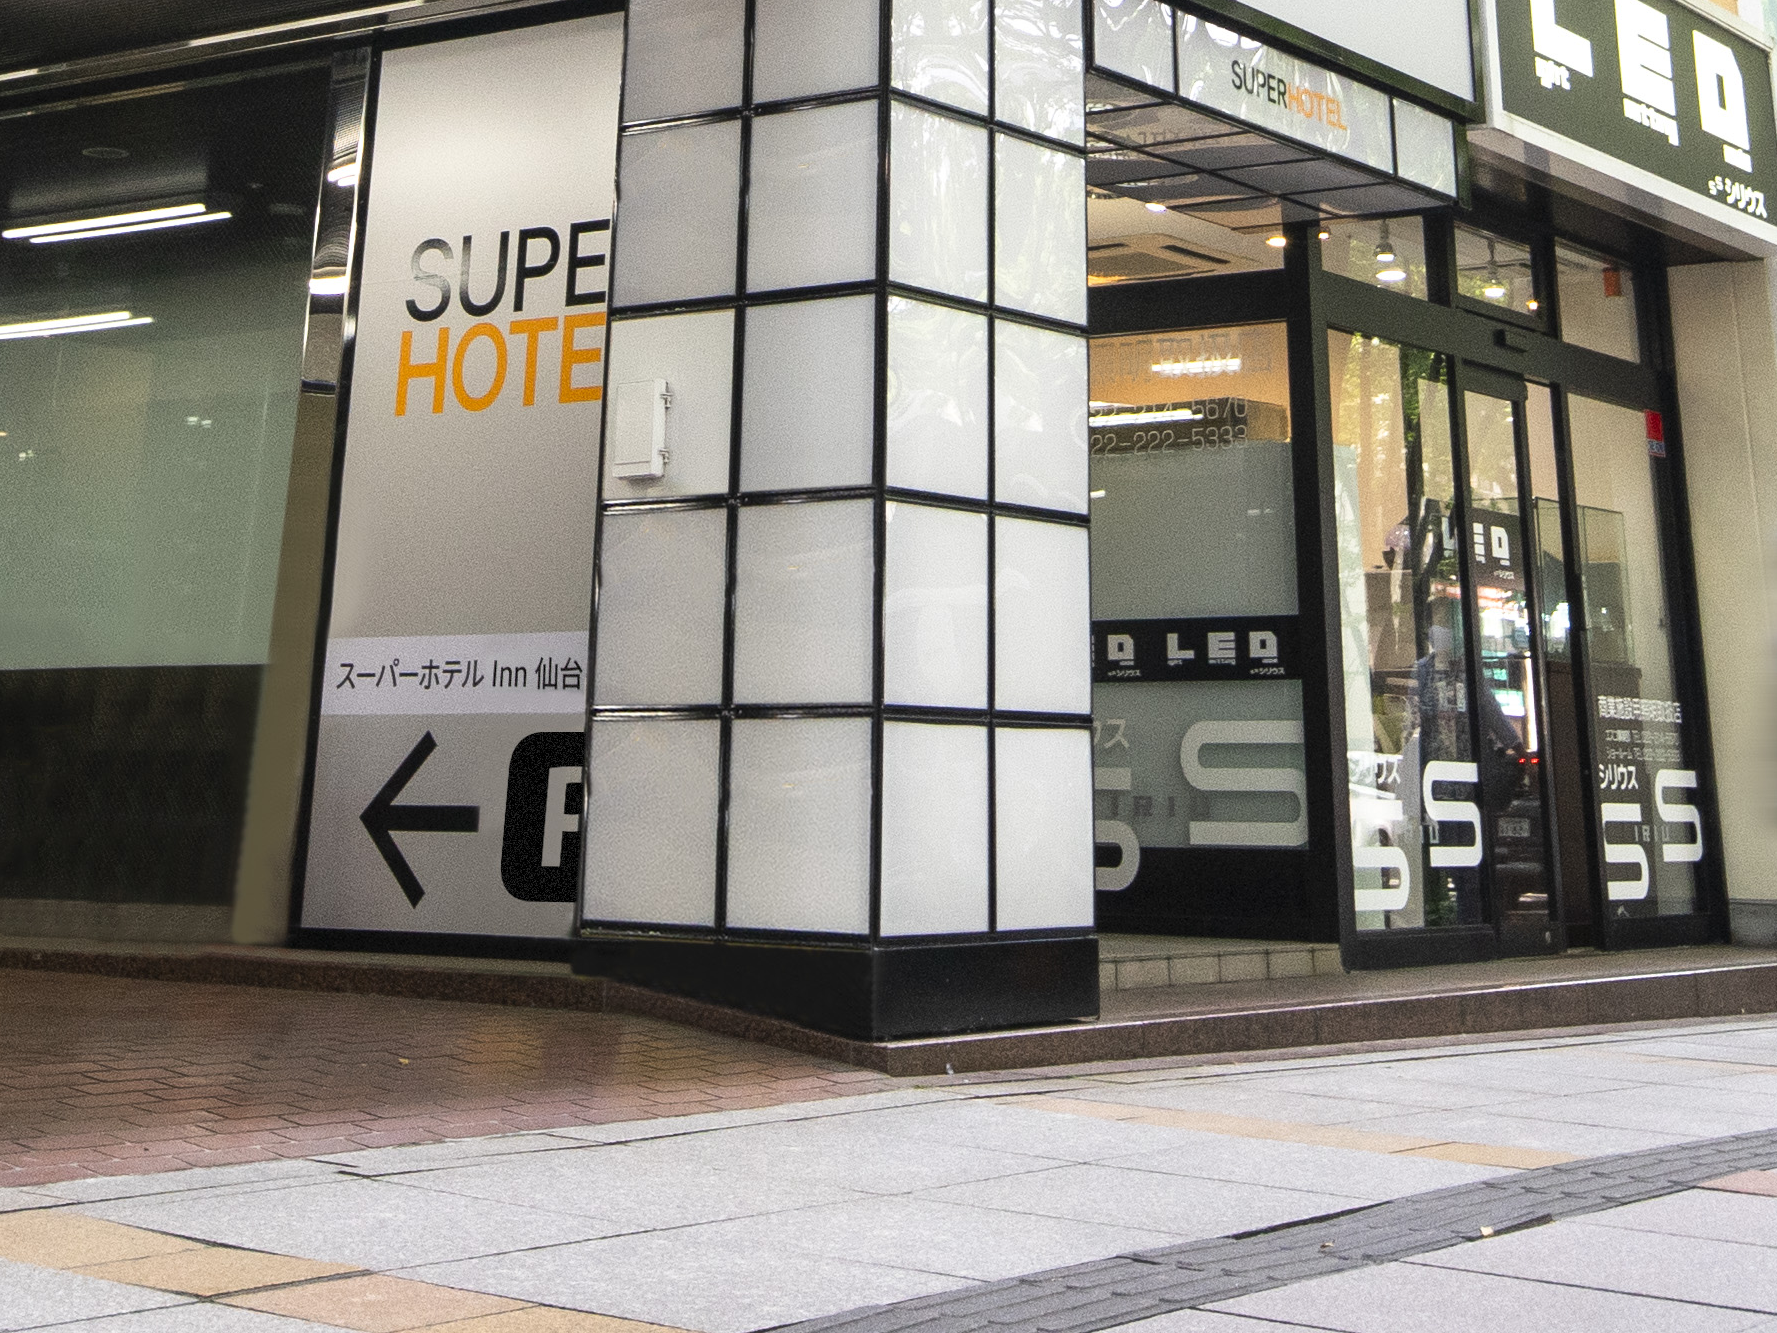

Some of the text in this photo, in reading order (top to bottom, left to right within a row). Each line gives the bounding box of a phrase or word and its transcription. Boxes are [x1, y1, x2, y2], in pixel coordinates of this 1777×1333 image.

[1724, 177, 1768, 219] シリウス
[405, 218, 611, 323] SUPE
[394, 311, 607, 417] HOTE
[1089, 425, 1249, 458] 22-222-5333
[1166, 631, 1279, 660] LED
[336, 657, 583, 691] スーパーホテル Inn 仙台
[1599, 764, 1639, 790] シリウス
